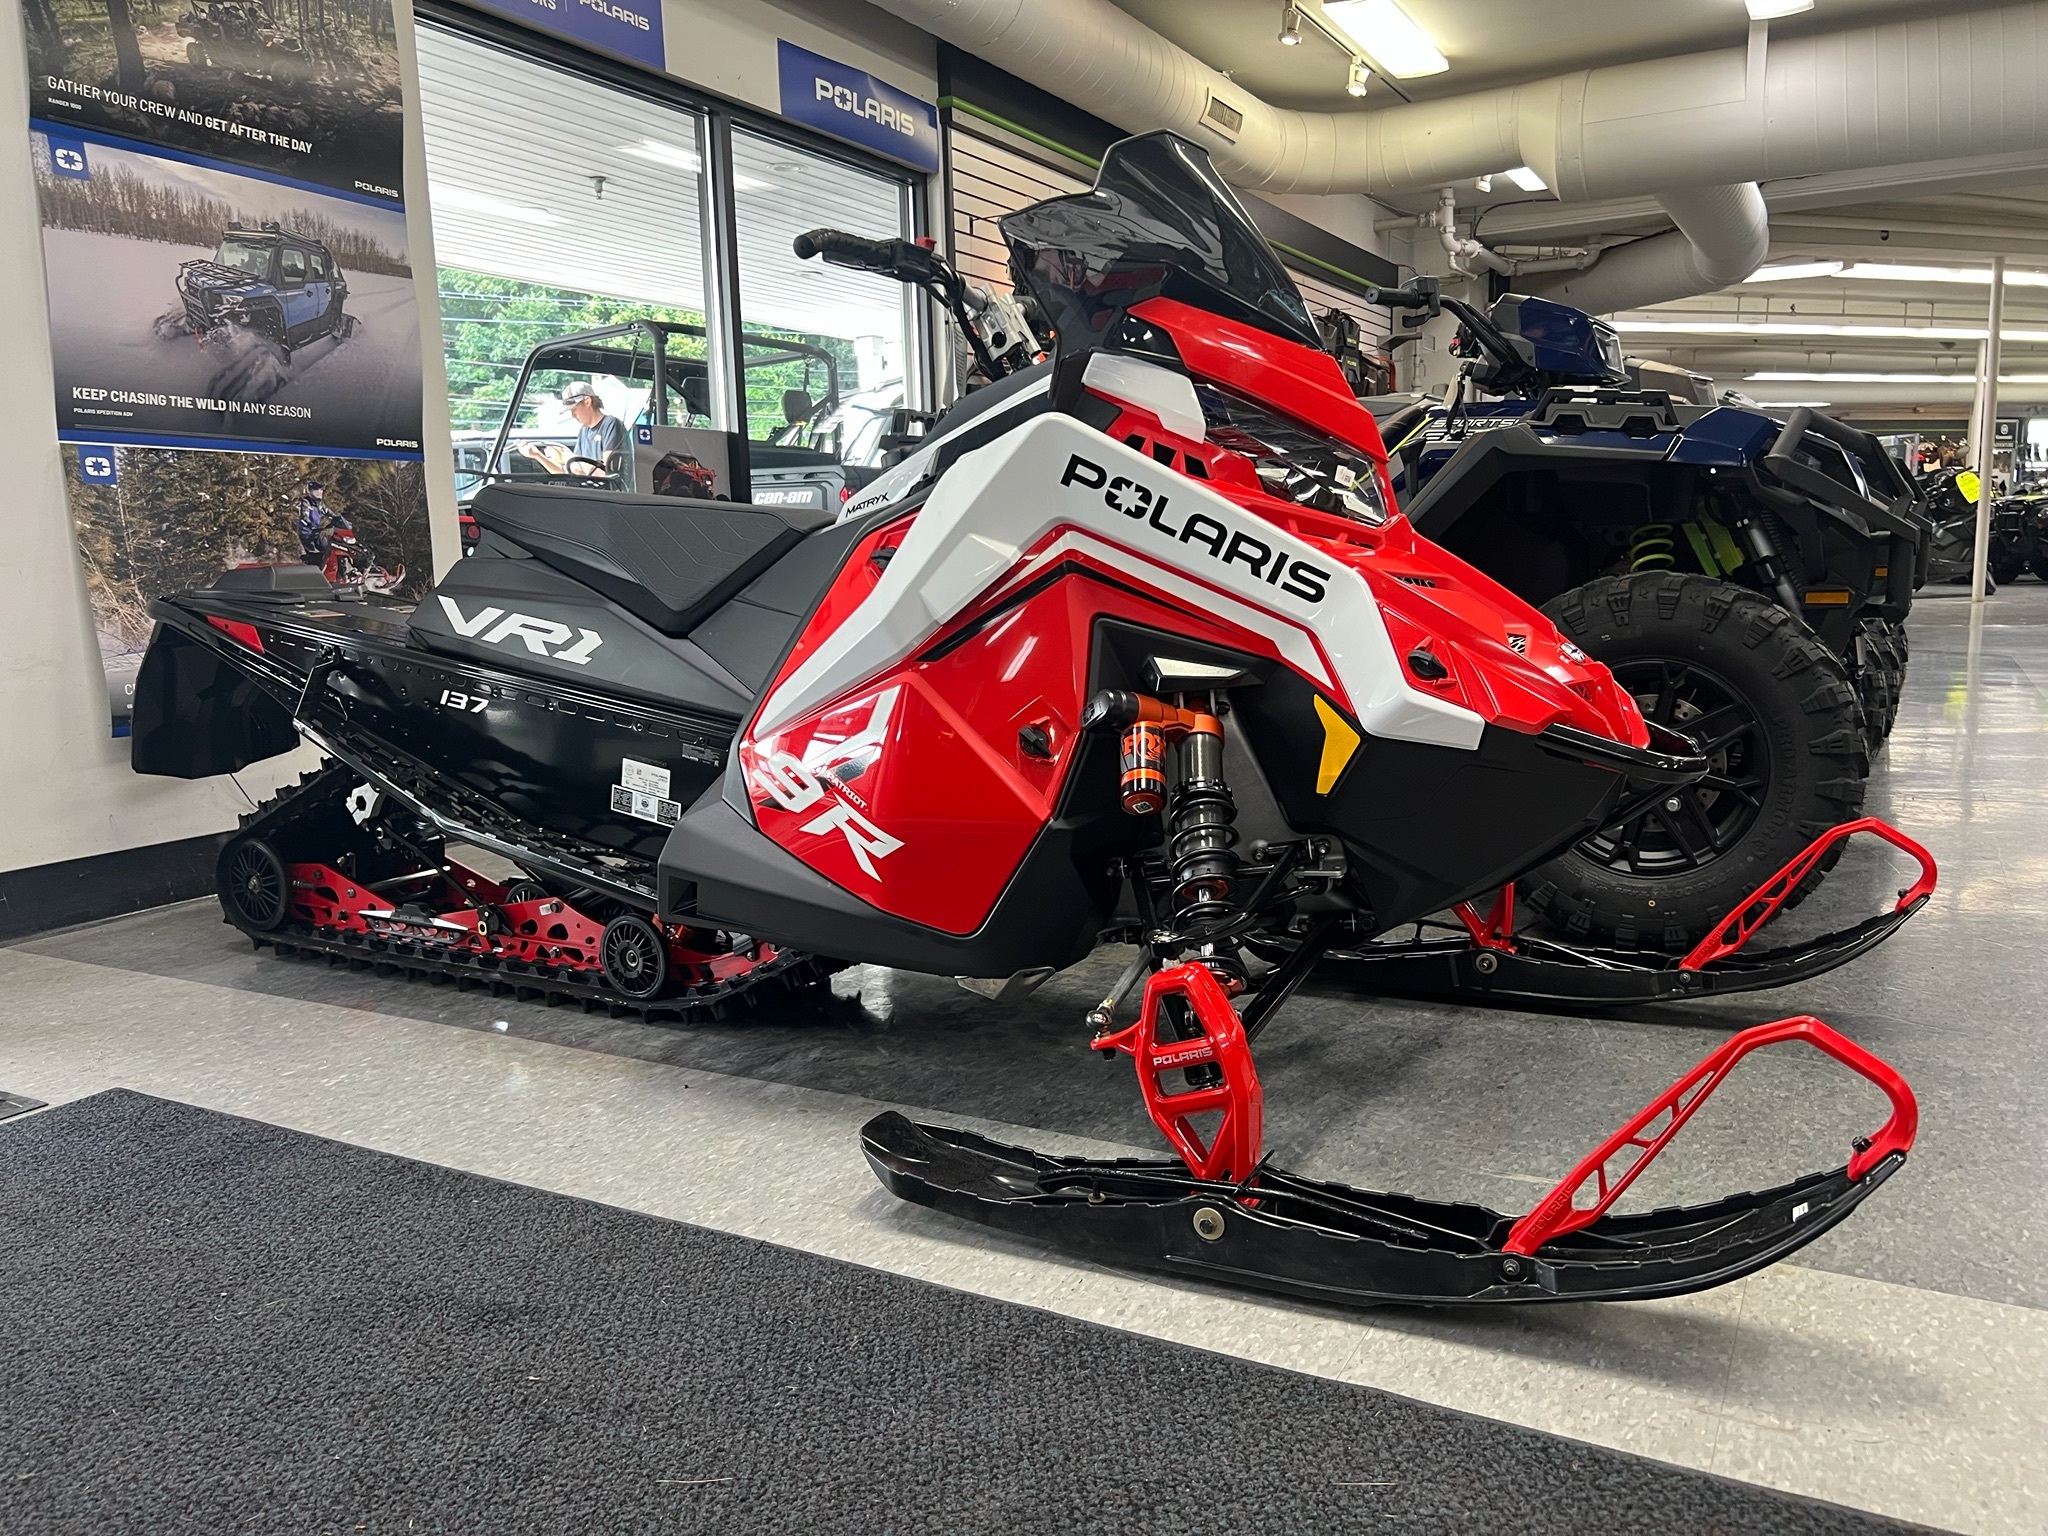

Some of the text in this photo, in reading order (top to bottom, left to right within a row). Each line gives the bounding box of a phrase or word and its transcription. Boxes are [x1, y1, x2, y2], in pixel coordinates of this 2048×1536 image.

[47, 75, 313, 154] GATHER YOUR CREW AND GET AFTER THE DAY
[815, 77, 915, 137] POLARIS
[354, 180, 399, 198] POLARIS
[72, 386, 312, 419] KEEP CHASING THE WILD IN ANY SEASON
[73, 407, 96, 415] POLARIS
[376, 437, 419, 448] POLARIS
[754, 490, 814, 505] can-am
[845, 491, 891, 518] MATRYX
[1060, 453, 1332, 604] POLARIS
[436, 594, 604, 666] VR1
[439, 689, 490, 714] 137
[1123, 731, 1167, 760] FOX
[826, 770, 868, 809] PATRIOT
[1152, 1046, 1214, 1067] POLARIS
[1528, 1183, 1575, 1239] POLARIS
